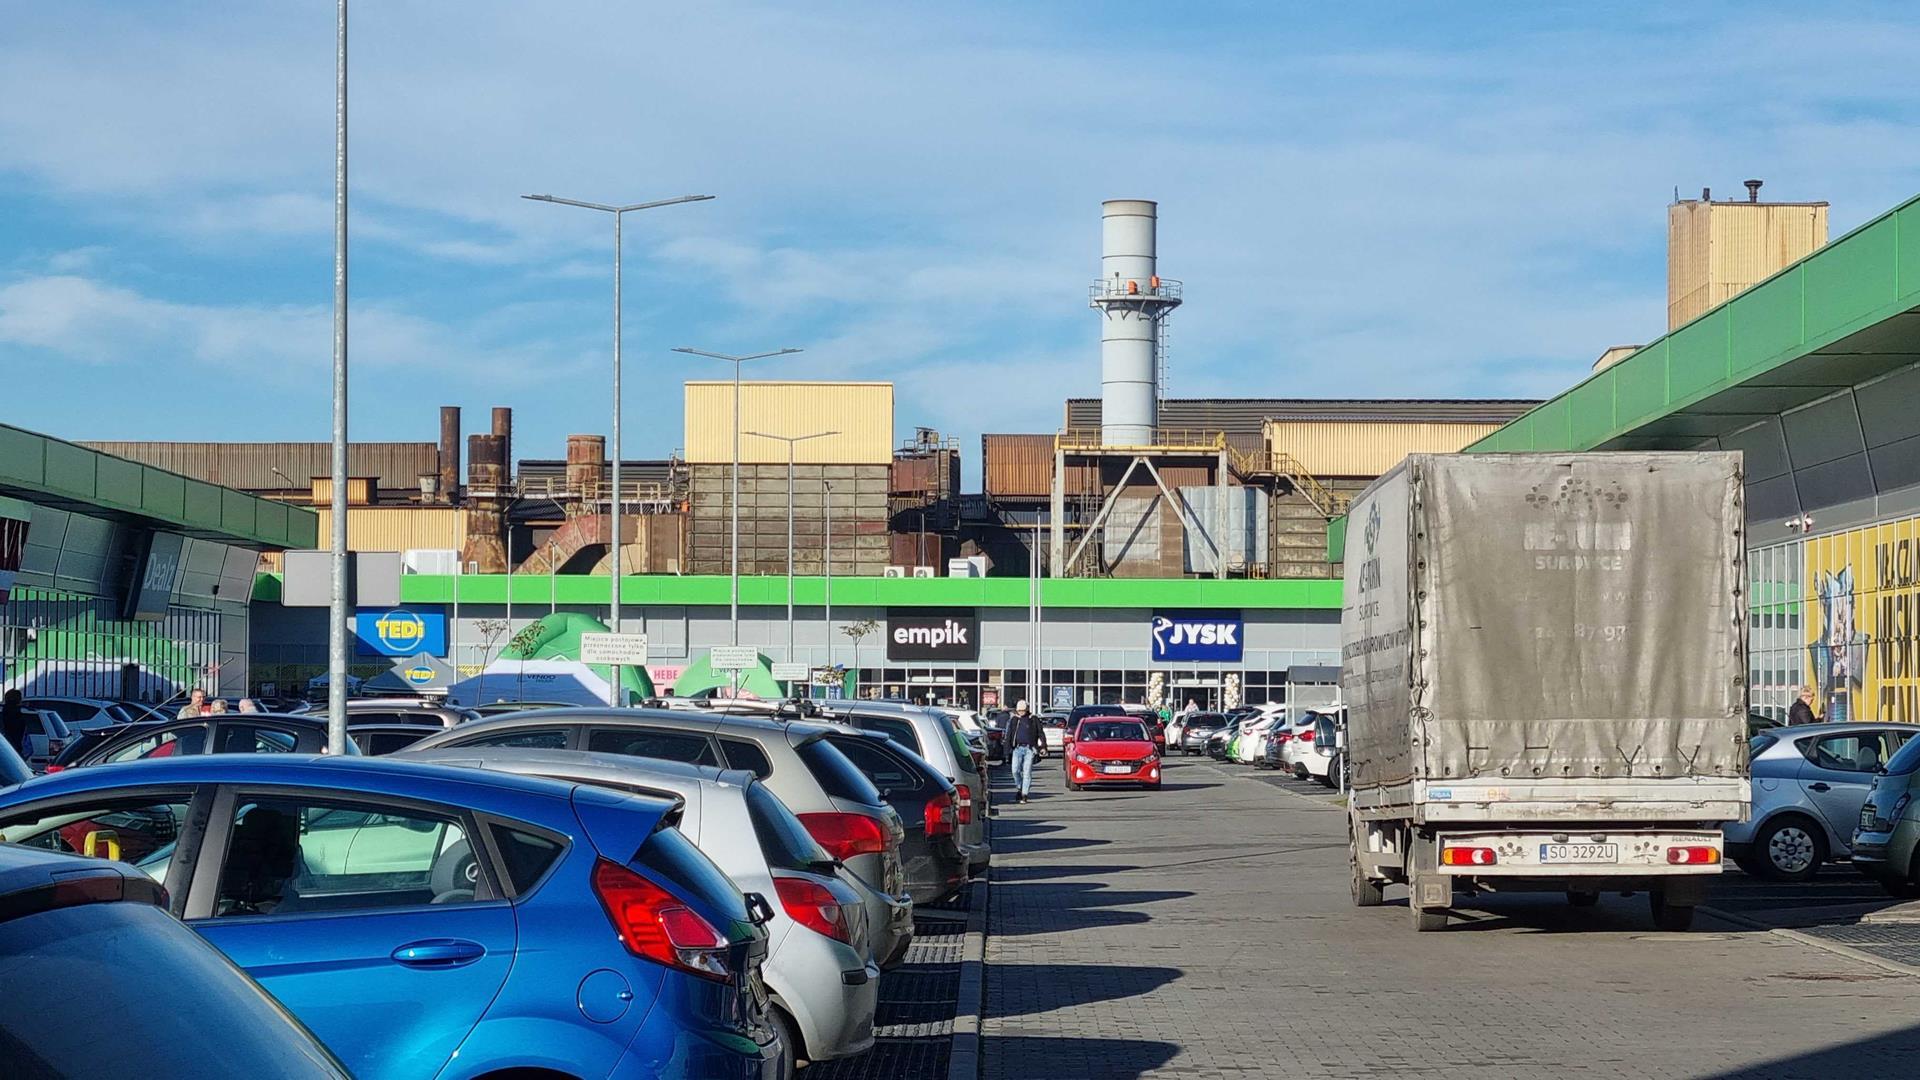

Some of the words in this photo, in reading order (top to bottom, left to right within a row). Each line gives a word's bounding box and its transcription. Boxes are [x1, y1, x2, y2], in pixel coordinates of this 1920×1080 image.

[143, 553, 175, 591] Dealz
[375, 619, 425, 639] TEDi
[893, 619, 968, 648] empik
[1169, 623, 1237, 645] JYSK
[405, 668, 436, 679] TEDi
[654, 670, 678, 679] HEBE
[1550, 846, 1567, 858] SO
[1573, 846, 1613, 858] 3292U
